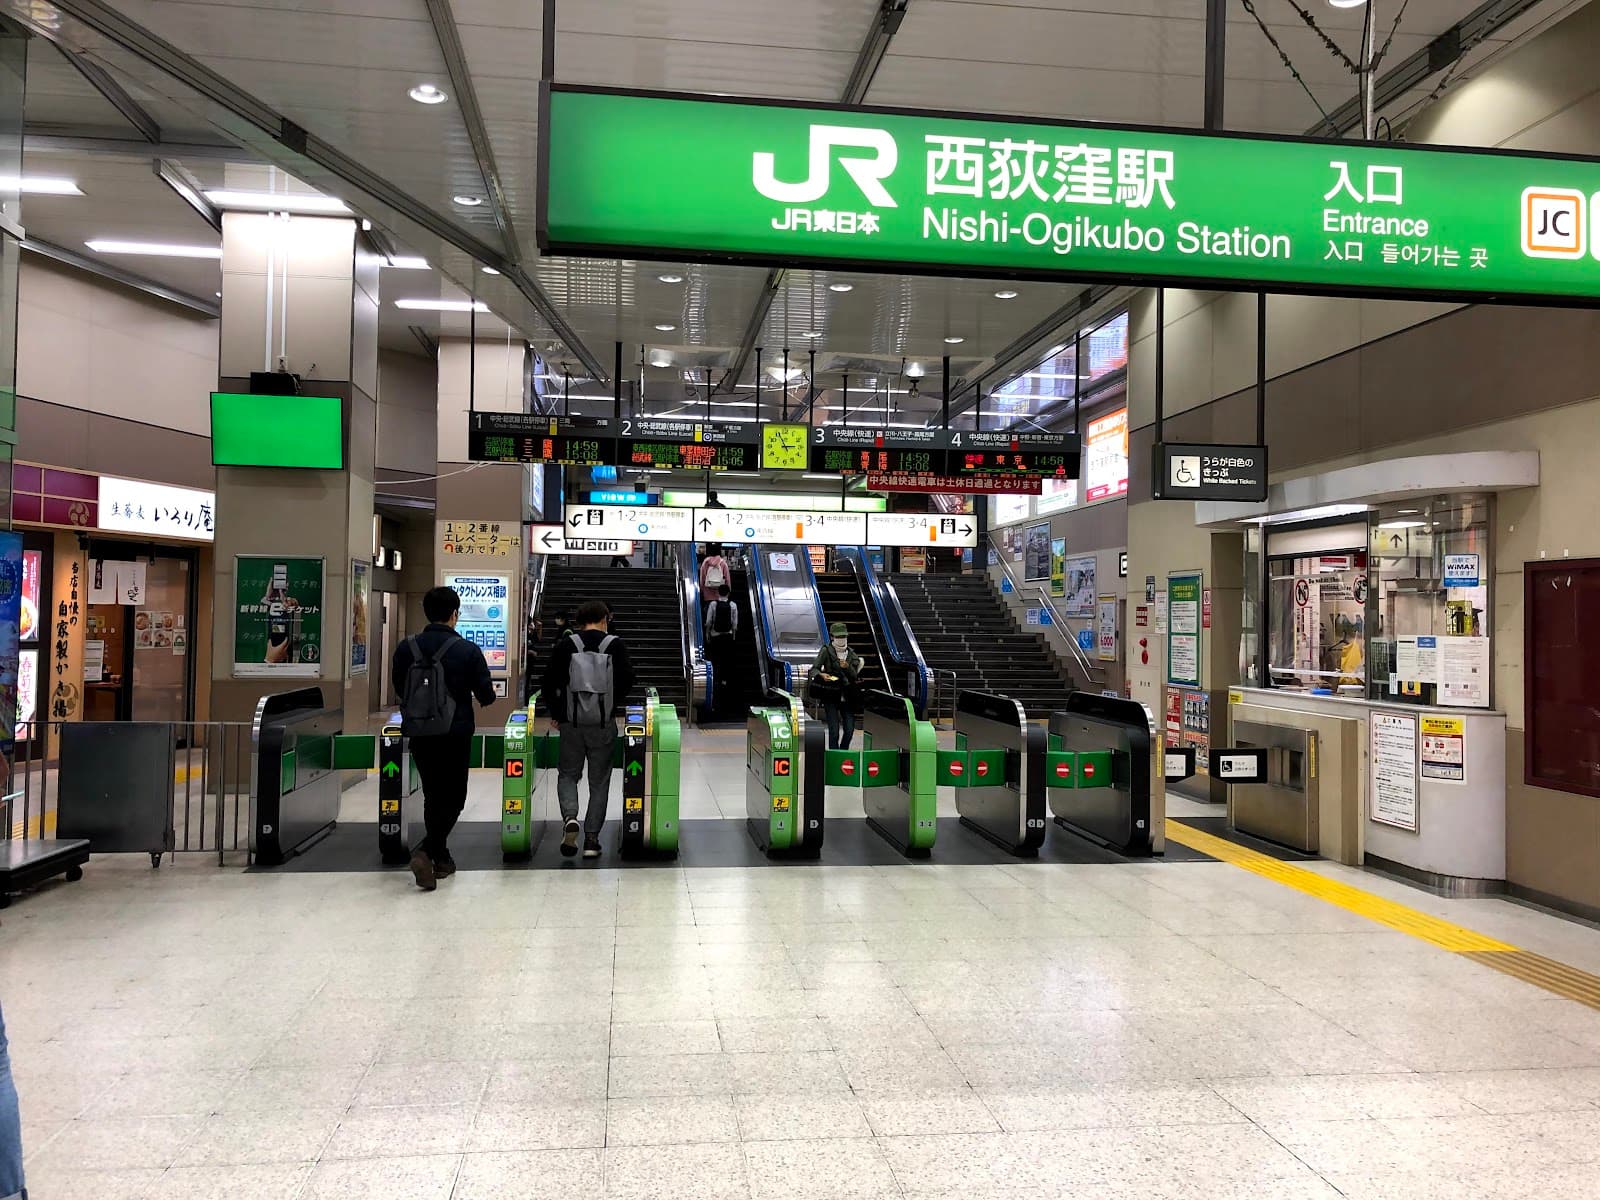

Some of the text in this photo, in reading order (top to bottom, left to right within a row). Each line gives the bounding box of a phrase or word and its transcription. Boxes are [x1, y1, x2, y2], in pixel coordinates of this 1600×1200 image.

[752, 124, 898, 208] JR
[924, 134, 1176, 210] 西荻窪駅
[1323, 160, 1404, 205] 入口
[771, 207, 880, 235] JR東日本
[1323, 209, 1429, 238] Entrance
[1537, 209, 1571, 238] JC
[923, 206, 1291, 259] Nishi-Ogikubo Station
[1323, 241, 1363, 262] 入口
[1381, 244, 1488, 269] 들어가는 곳
[621, 420, 632, 436] 2
[815, 428, 825, 443] 3
[951, 432, 962, 447] 4
[900, 452, 930, 462] 14:59
[1034, 456, 1064, 466] 14:58
[1203, 456, 1254, 468] うらが白色の
[1203, 468, 1229, 477] きっぷ
[154, 500, 213, 532] いろり庵
[444, 533, 520, 546] エレベーターは
[454, 544, 507, 556] 後方です。
[68, 561, 80, 626] 当店自慢の
[448, 585, 507, 599] ンタクトレンズ相談
[773, 726, 791, 739] IC
[507, 741, 523, 750] 専用
[507, 760, 523, 777] IC
[774, 760, 789, 775] IC
